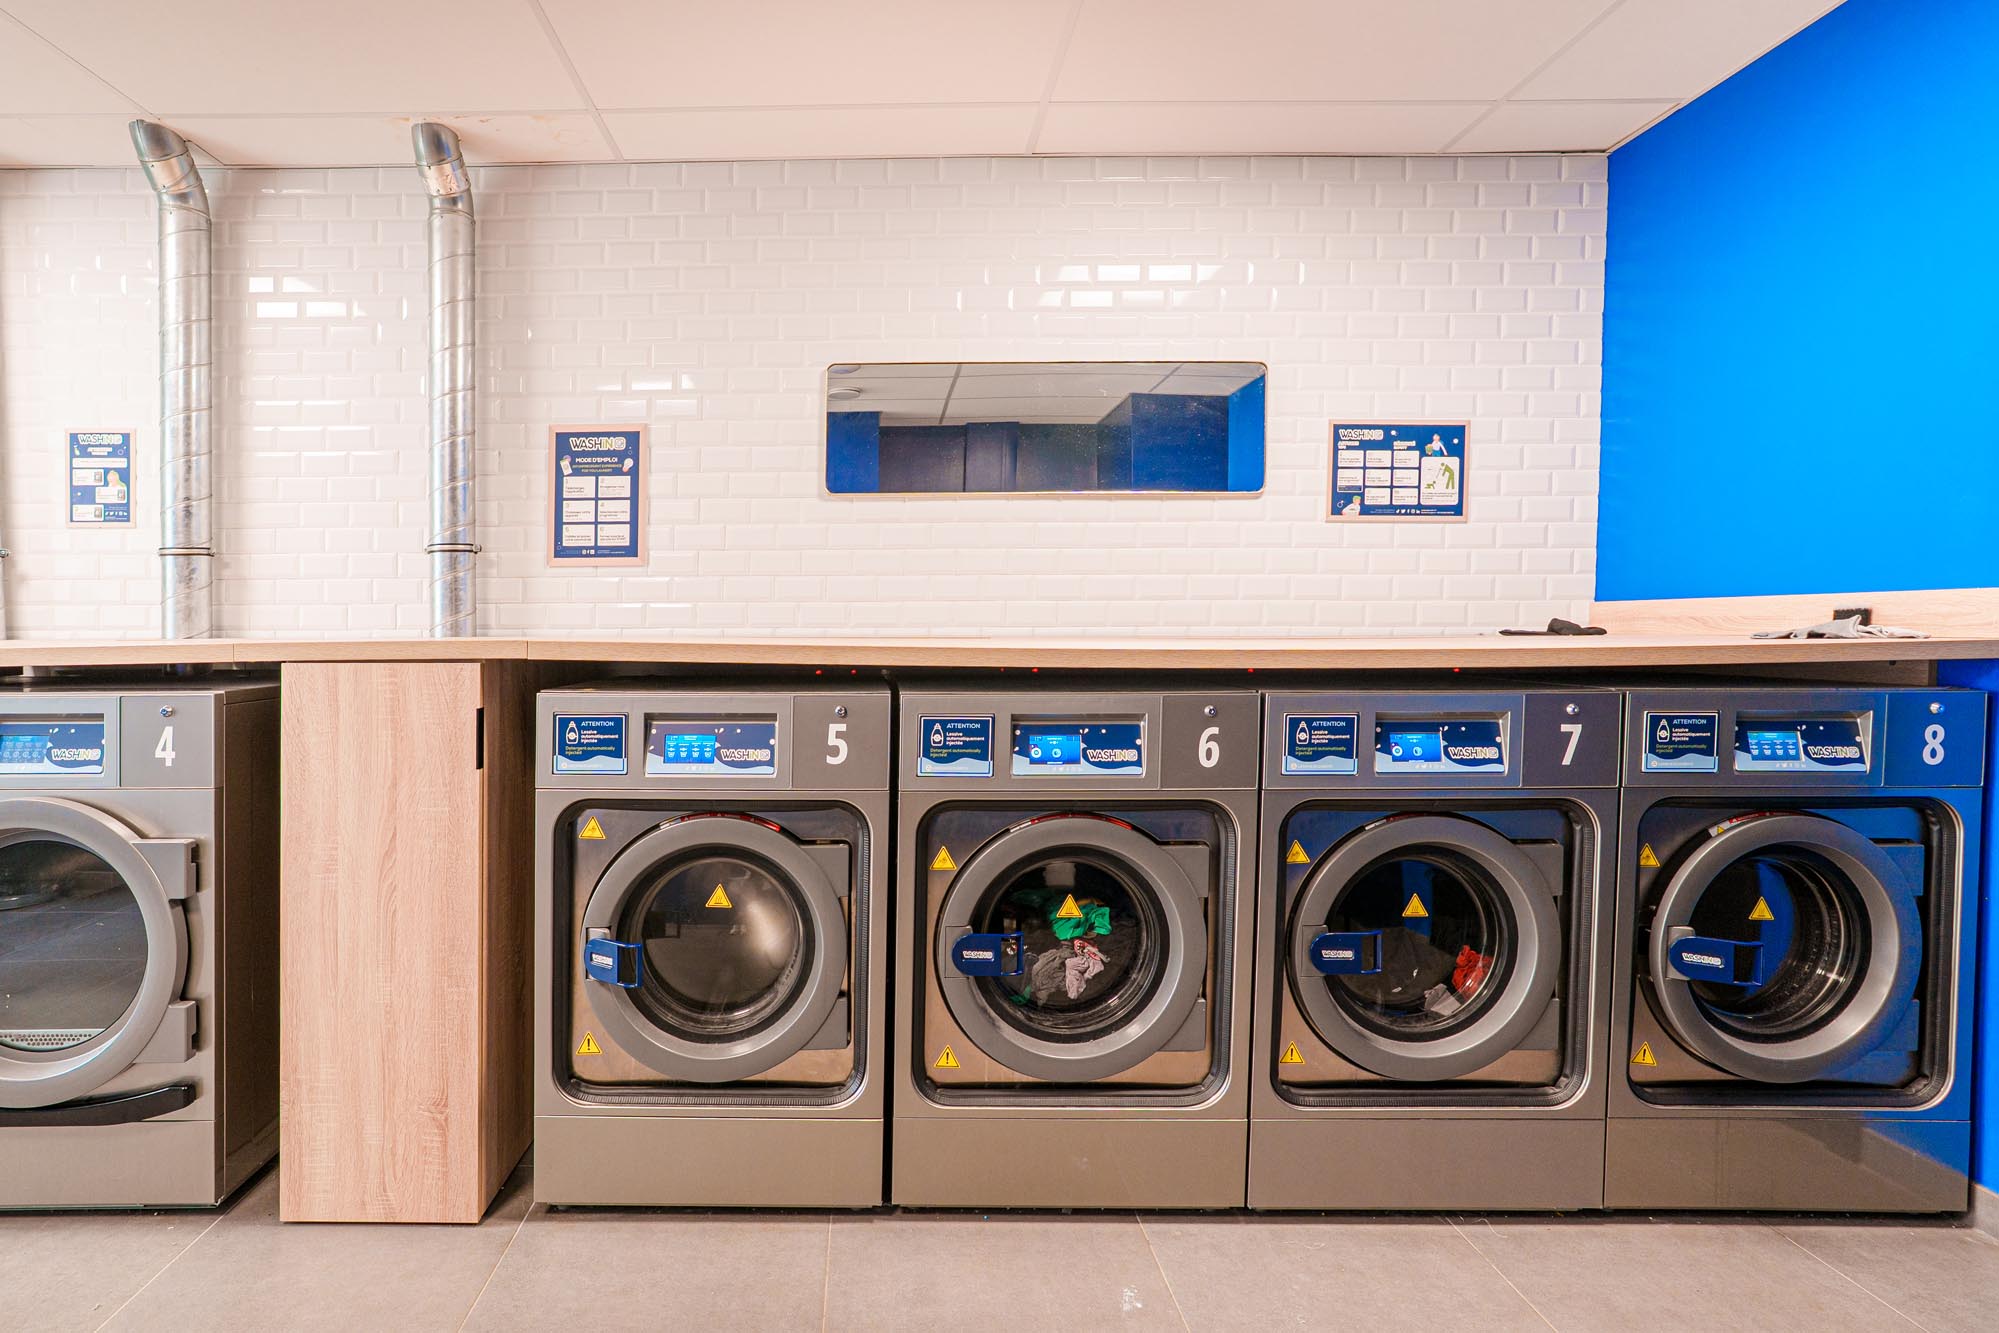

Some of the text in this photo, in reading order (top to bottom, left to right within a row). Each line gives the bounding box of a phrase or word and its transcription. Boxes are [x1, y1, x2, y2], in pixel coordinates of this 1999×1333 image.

[155, 726, 176, 767] 4
[826, 723, 848, 764] 5
[1198, 726, 1220, 768] 6
[1560, 724, 1582, 766] 7
[1922, 724, 1945, 765] 8
